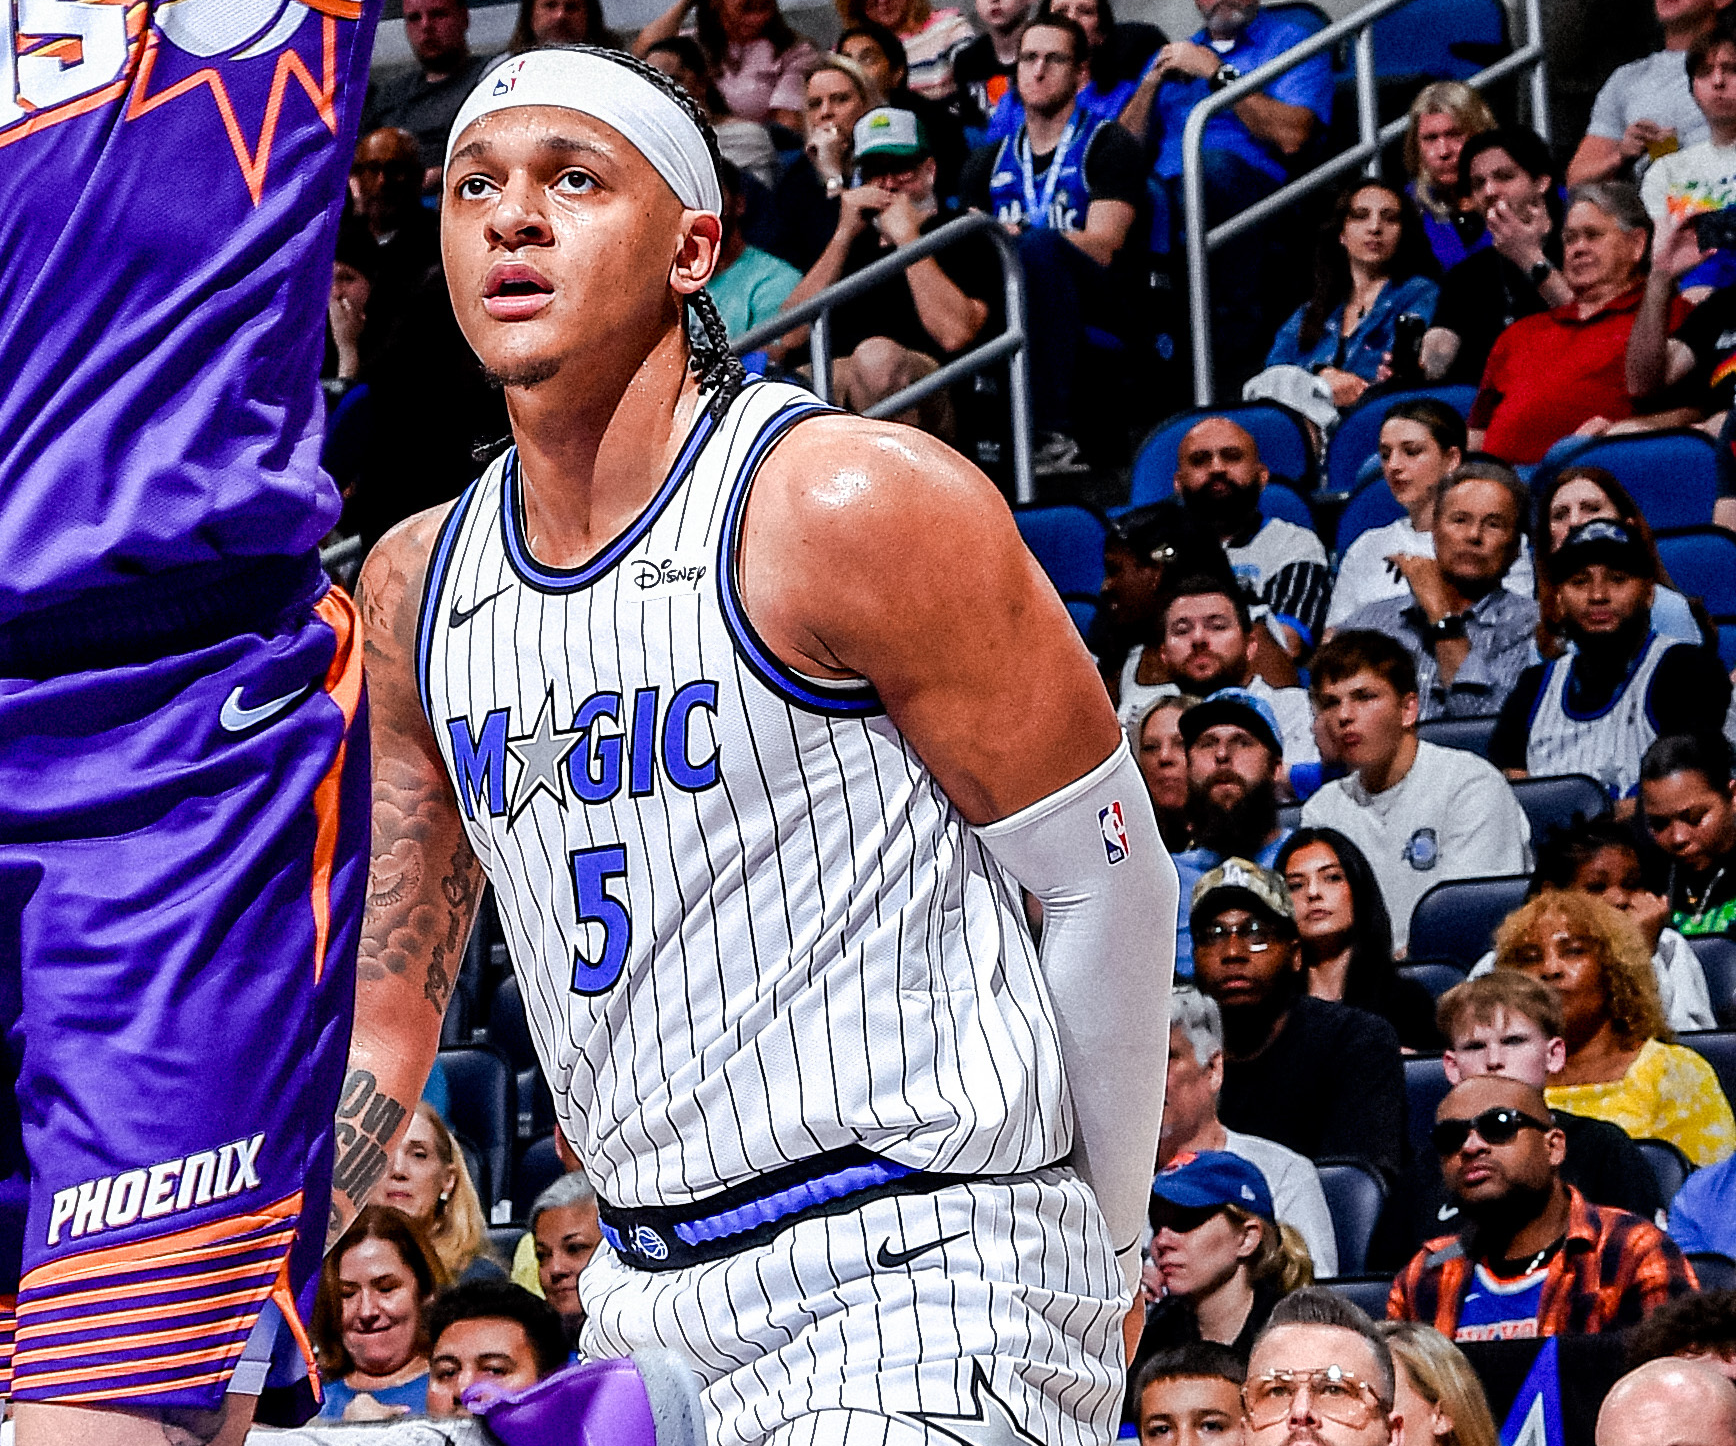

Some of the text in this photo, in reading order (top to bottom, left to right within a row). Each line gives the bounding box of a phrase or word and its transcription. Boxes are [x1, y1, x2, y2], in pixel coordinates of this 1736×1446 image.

[633, 558, 707, 592] Disney
[568, 844, 632, 996] 5
[47, 1132, 265, 1246] PHOENIX
